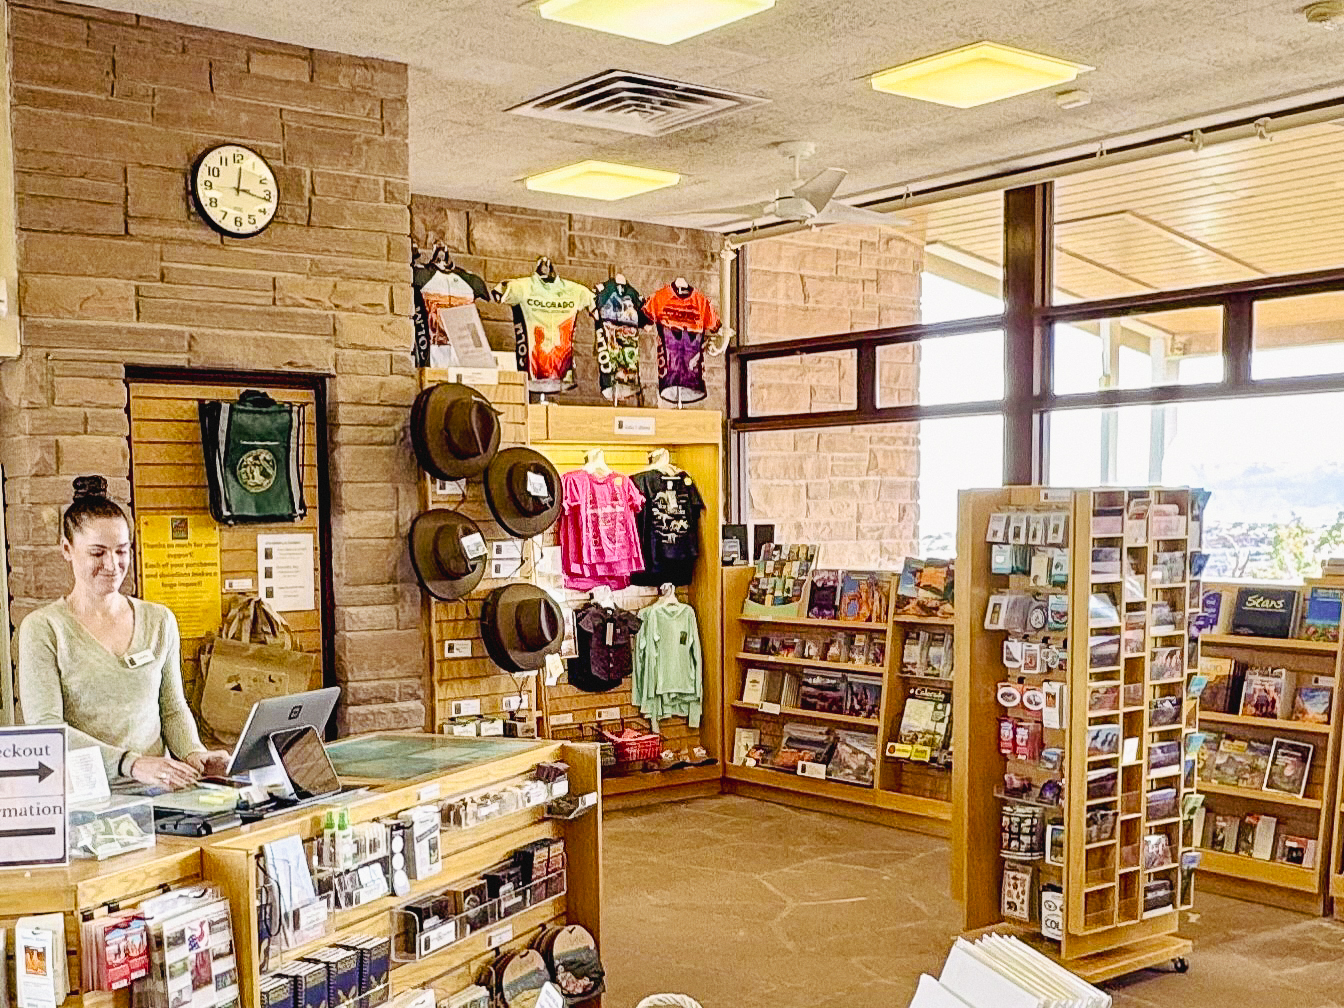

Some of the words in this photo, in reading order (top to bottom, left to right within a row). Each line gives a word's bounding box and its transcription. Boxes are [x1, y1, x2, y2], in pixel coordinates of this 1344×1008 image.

[219, 156, 228, 166] 11
[233, 153, 244, 164] 12
[207, 166, 220, 178] 10
[203, 180, 213, 190] 9
[209, 197, 218, 208] 8
[220, 209, 228, 220] 7
[248, 214, 256, 225] 5
[234, 216, 243, 227] 6
[527, 298, 575, 309] COLORADO
[143, 541, 166, 549] Thanks
[1244, 594, 1285, 609] Stars
